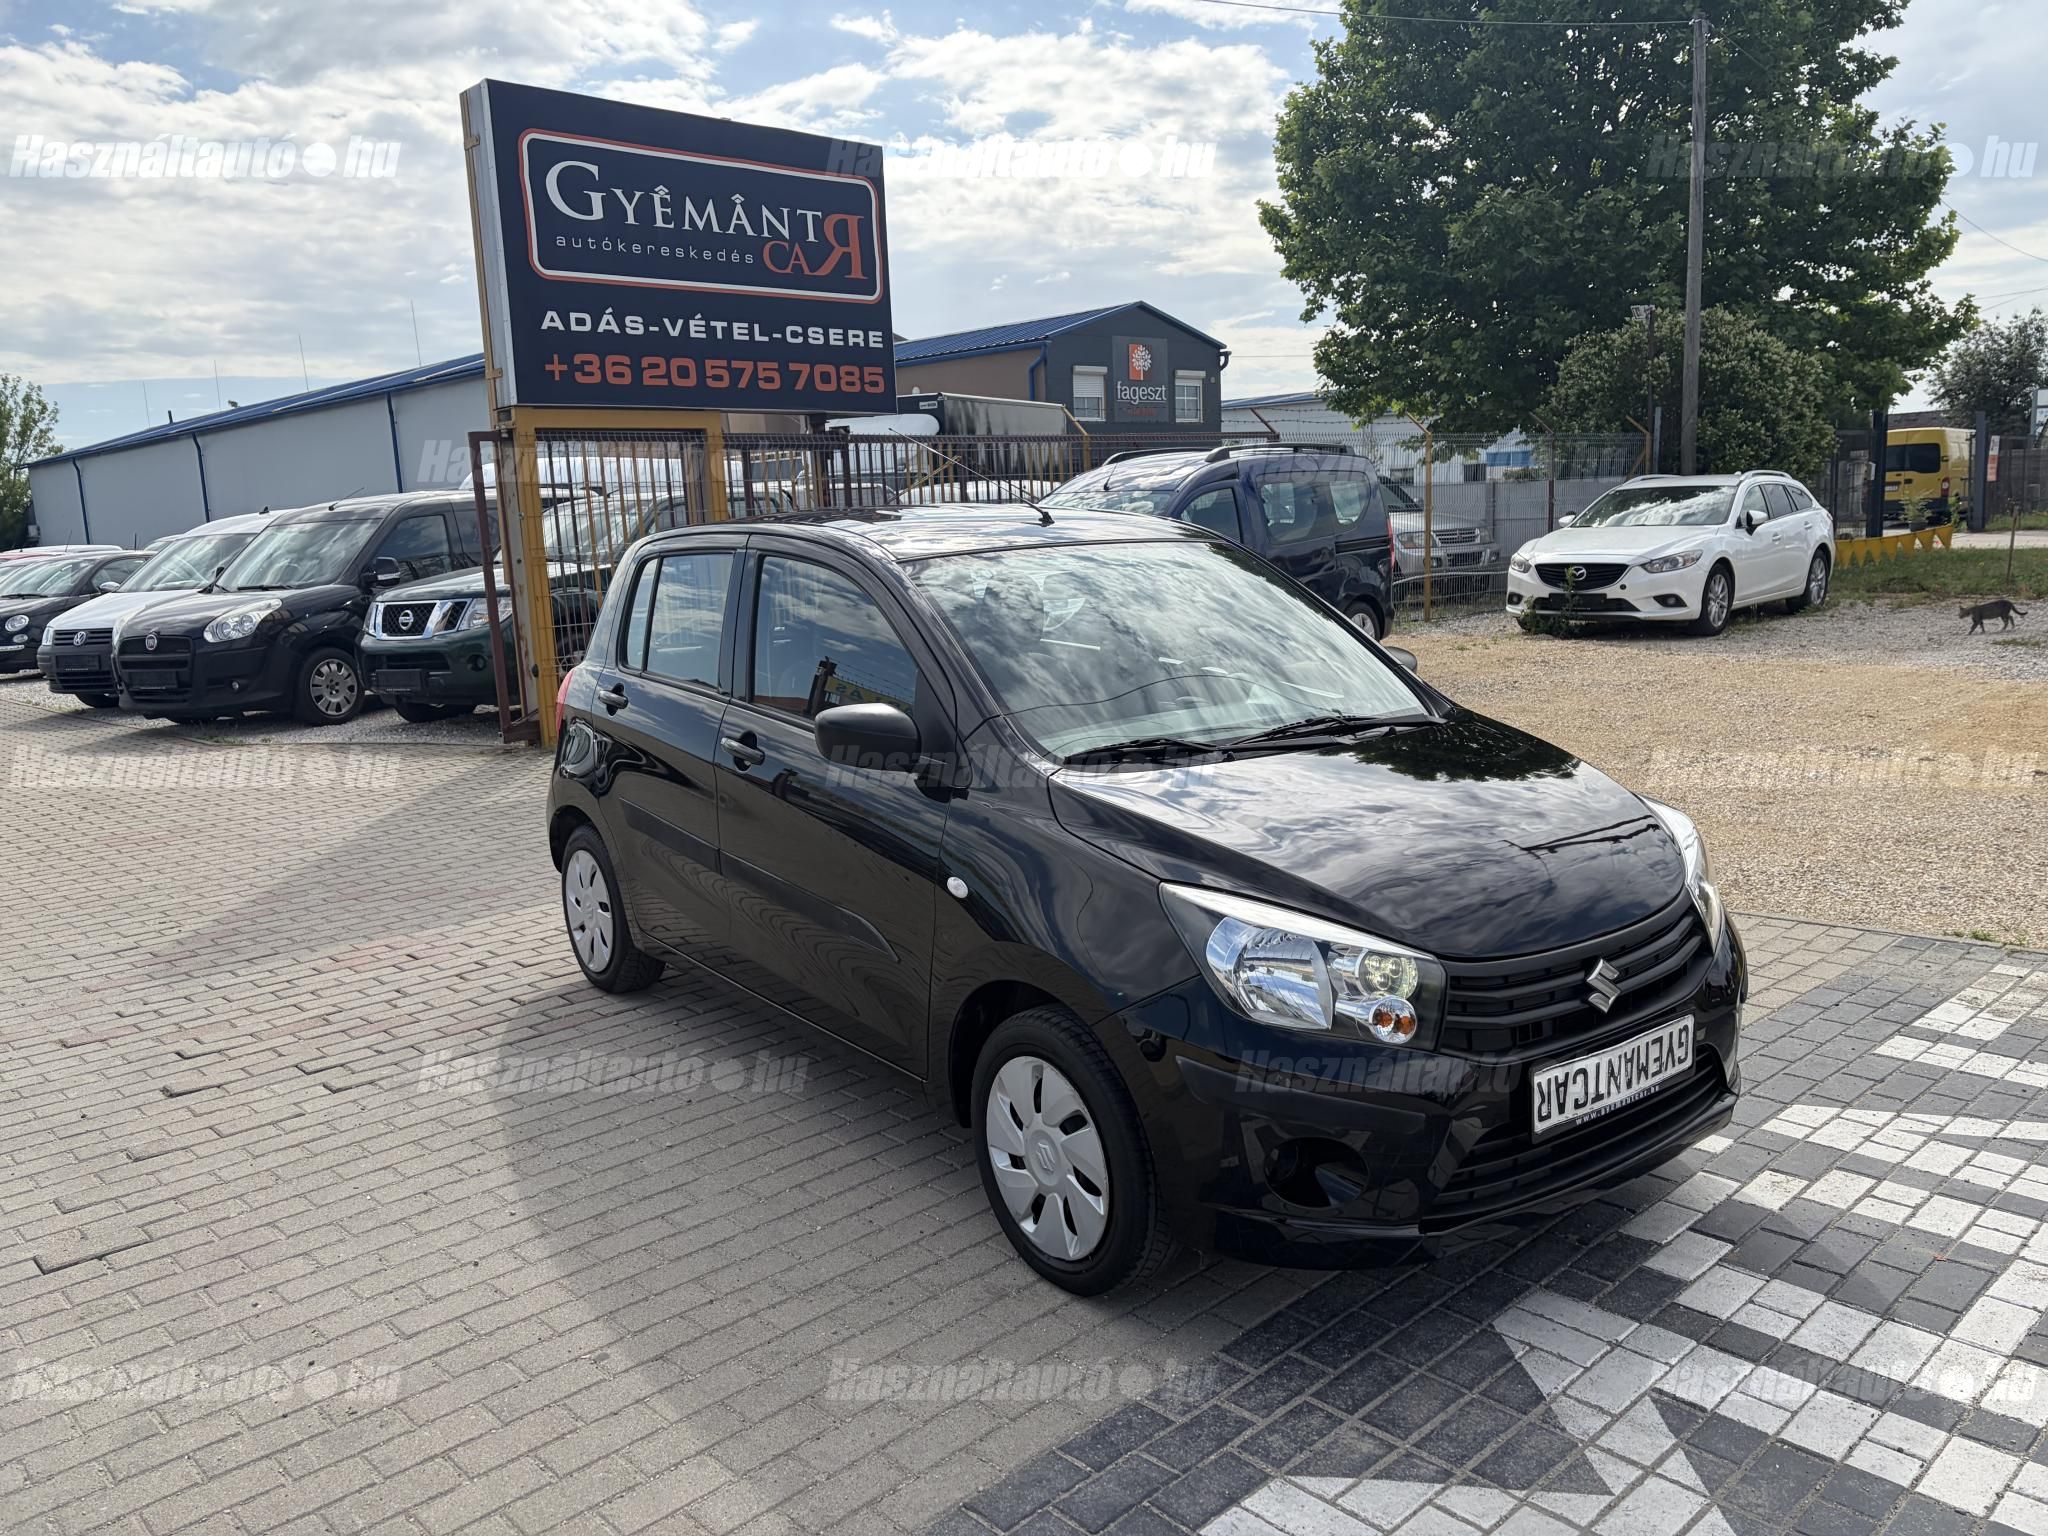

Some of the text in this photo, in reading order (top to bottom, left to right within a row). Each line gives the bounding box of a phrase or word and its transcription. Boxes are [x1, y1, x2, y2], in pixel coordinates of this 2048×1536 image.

[556, 235, 754, 264] autókereskedés
[540, 306, 884, 348] ADÁS-VÉTEL-CSERE
[544, 353, 886, 394] +36 20 575 7085
[1117, 380, 1168, 405] fageszt
[1536, 1023, 1690, 1123] GYEMANTCAR
